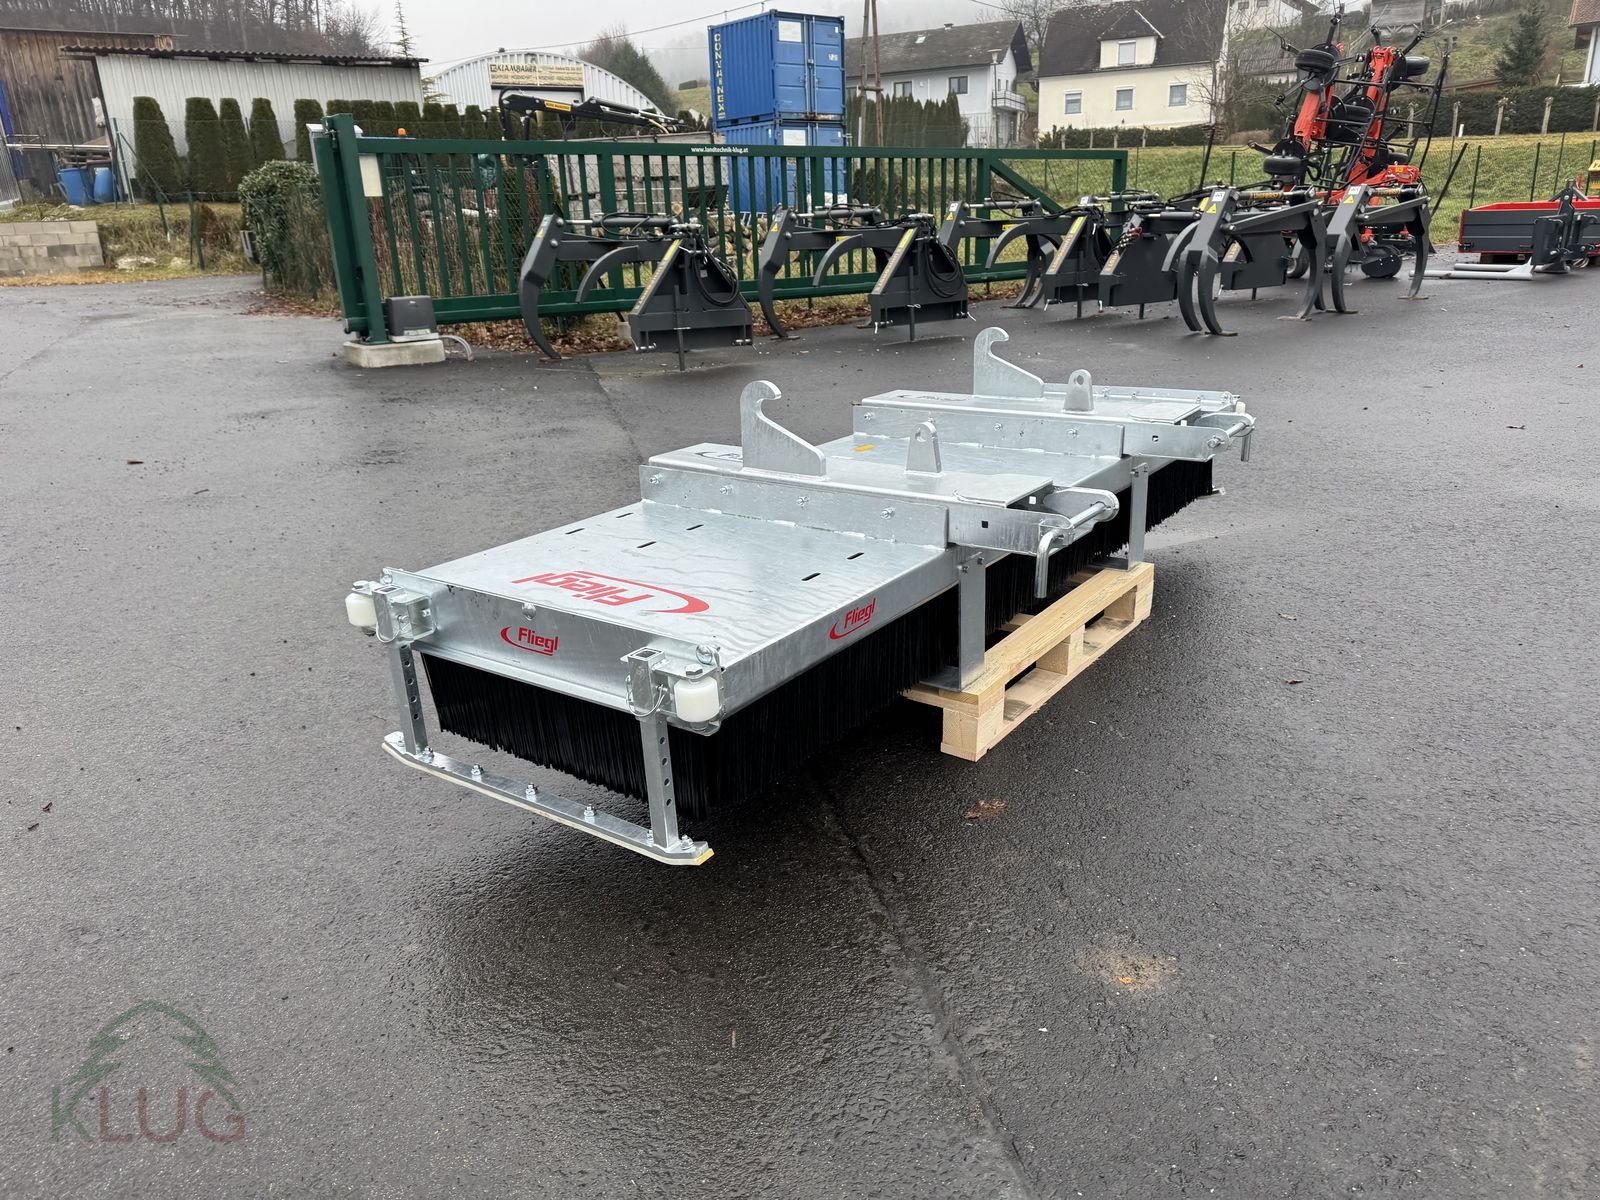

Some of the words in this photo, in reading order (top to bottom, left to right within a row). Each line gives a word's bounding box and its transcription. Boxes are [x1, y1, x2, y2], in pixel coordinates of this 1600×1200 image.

[690, 146, 749, 154] www.landtechnik-klug.at
[511, 571, 656, 606] Fliegl
[843, 597, 876, 629] Fliegl
[518, 627, 559, 653] Fliegl
